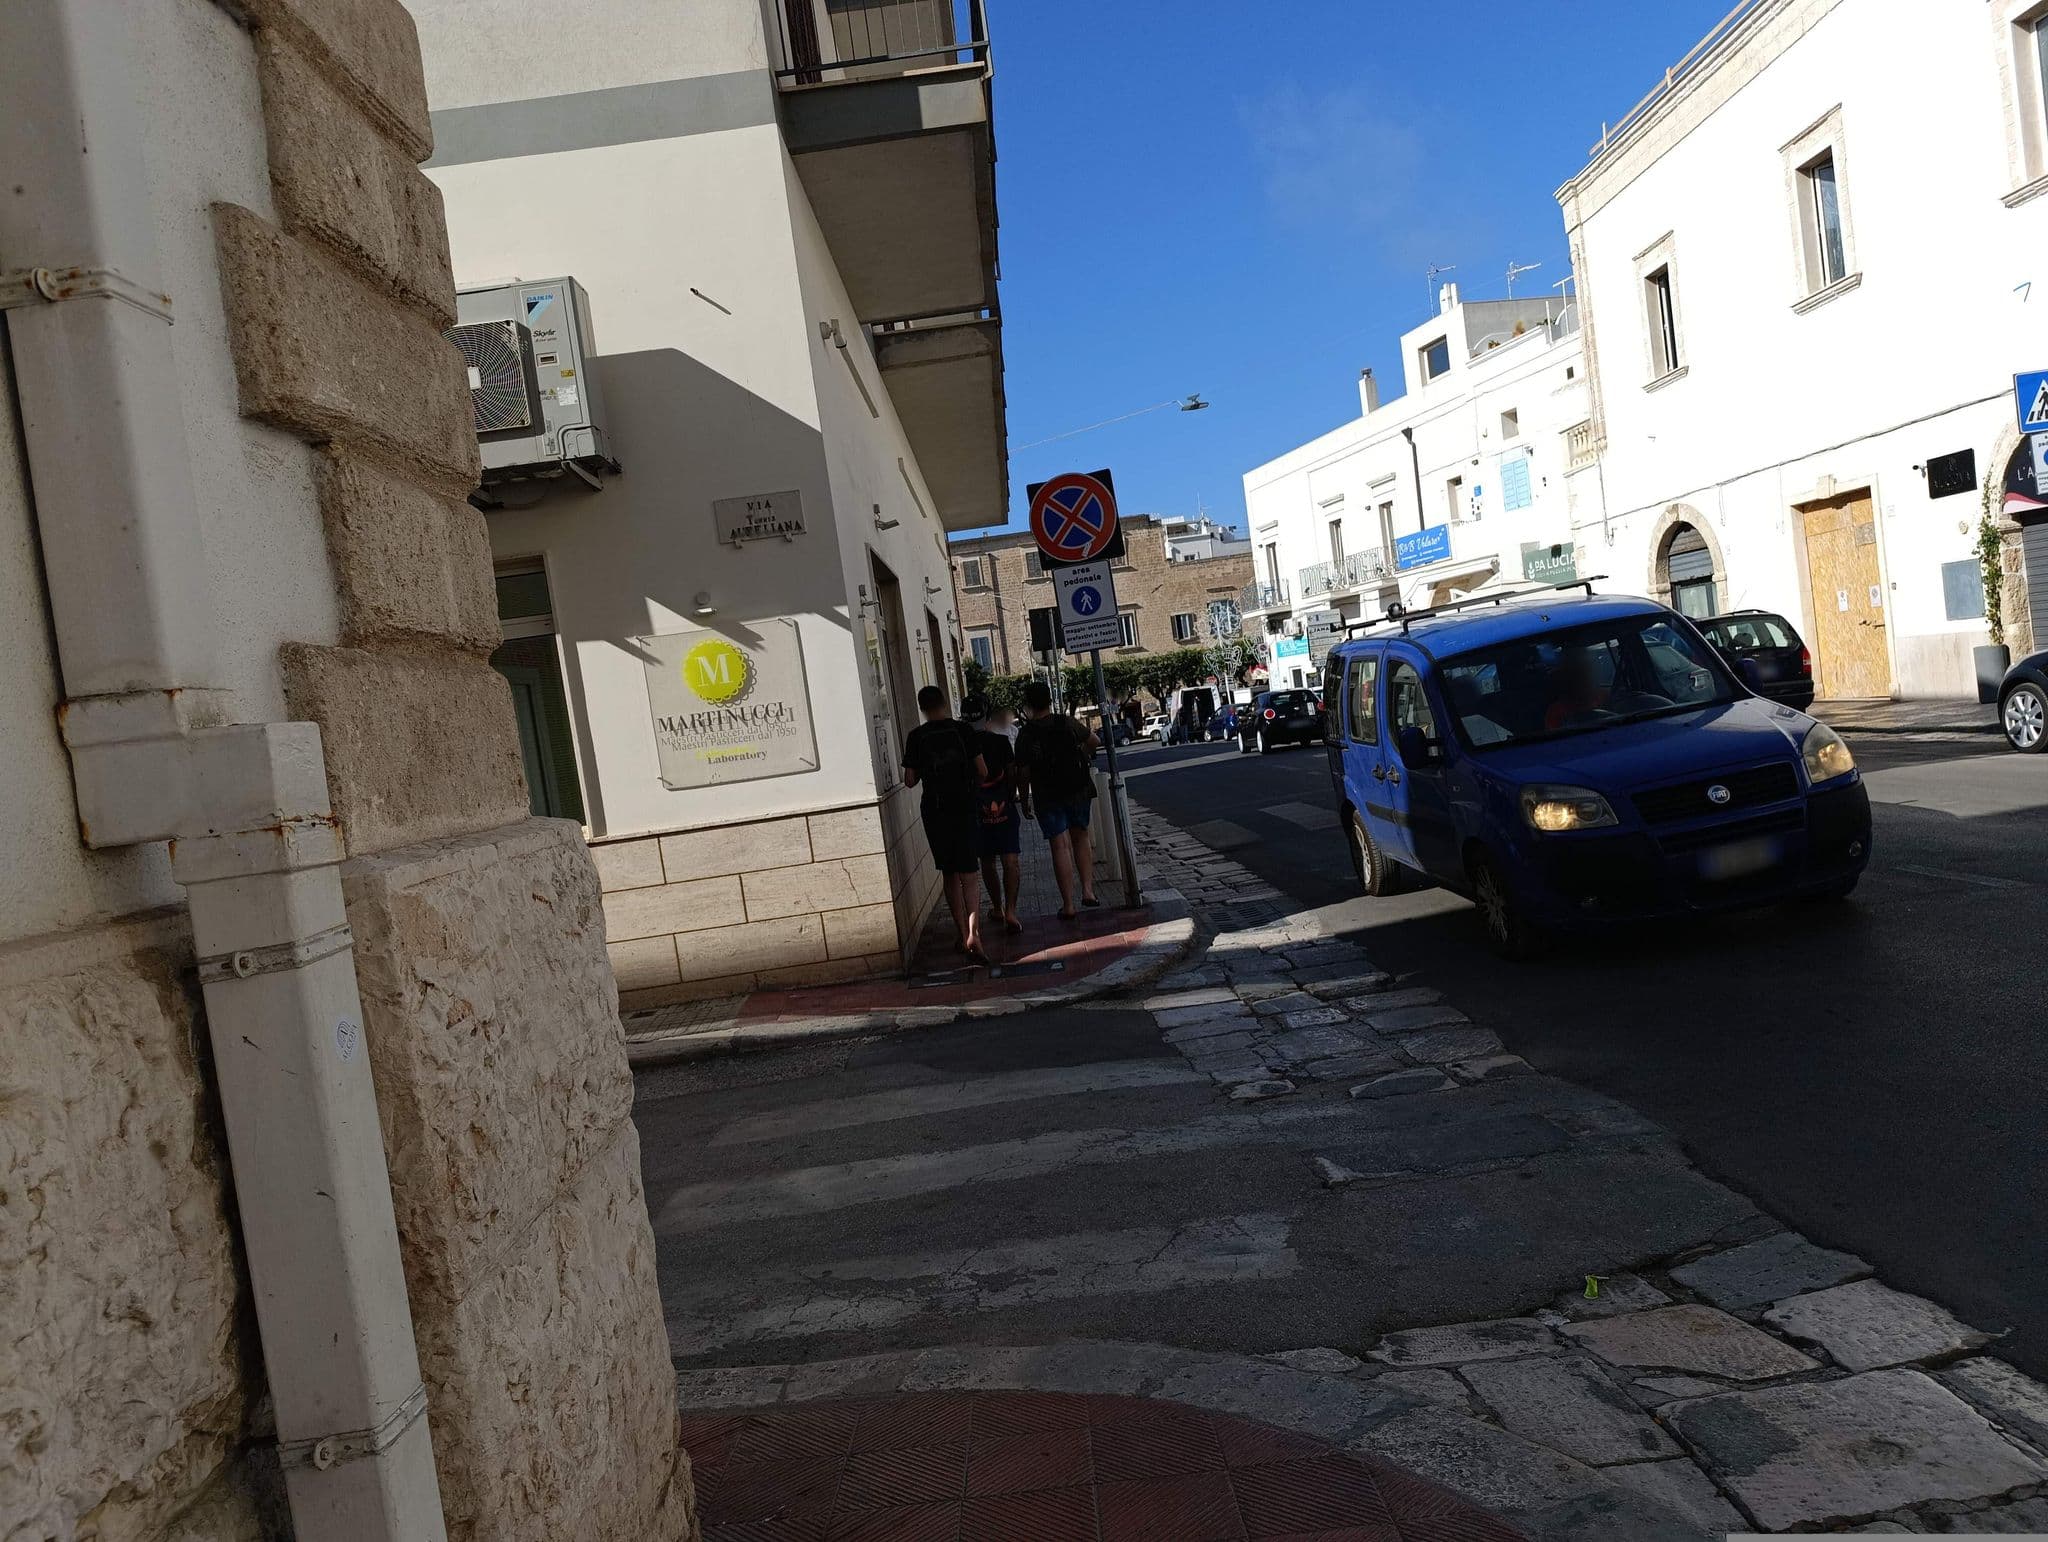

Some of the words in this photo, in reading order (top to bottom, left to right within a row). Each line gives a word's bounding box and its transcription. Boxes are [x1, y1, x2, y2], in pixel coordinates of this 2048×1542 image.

[746, 499, 772, 511] VIA
[1546, 552, 1575, 569] LUCIA
[1072, 567, 1090, 575] area
[1063, 573, 1102, 587] pedonale
[697, 652, 733, 688] M
[657, 701, 785, 733] MARTINUCCI
[707, 750, 768, 765] Laboratory
